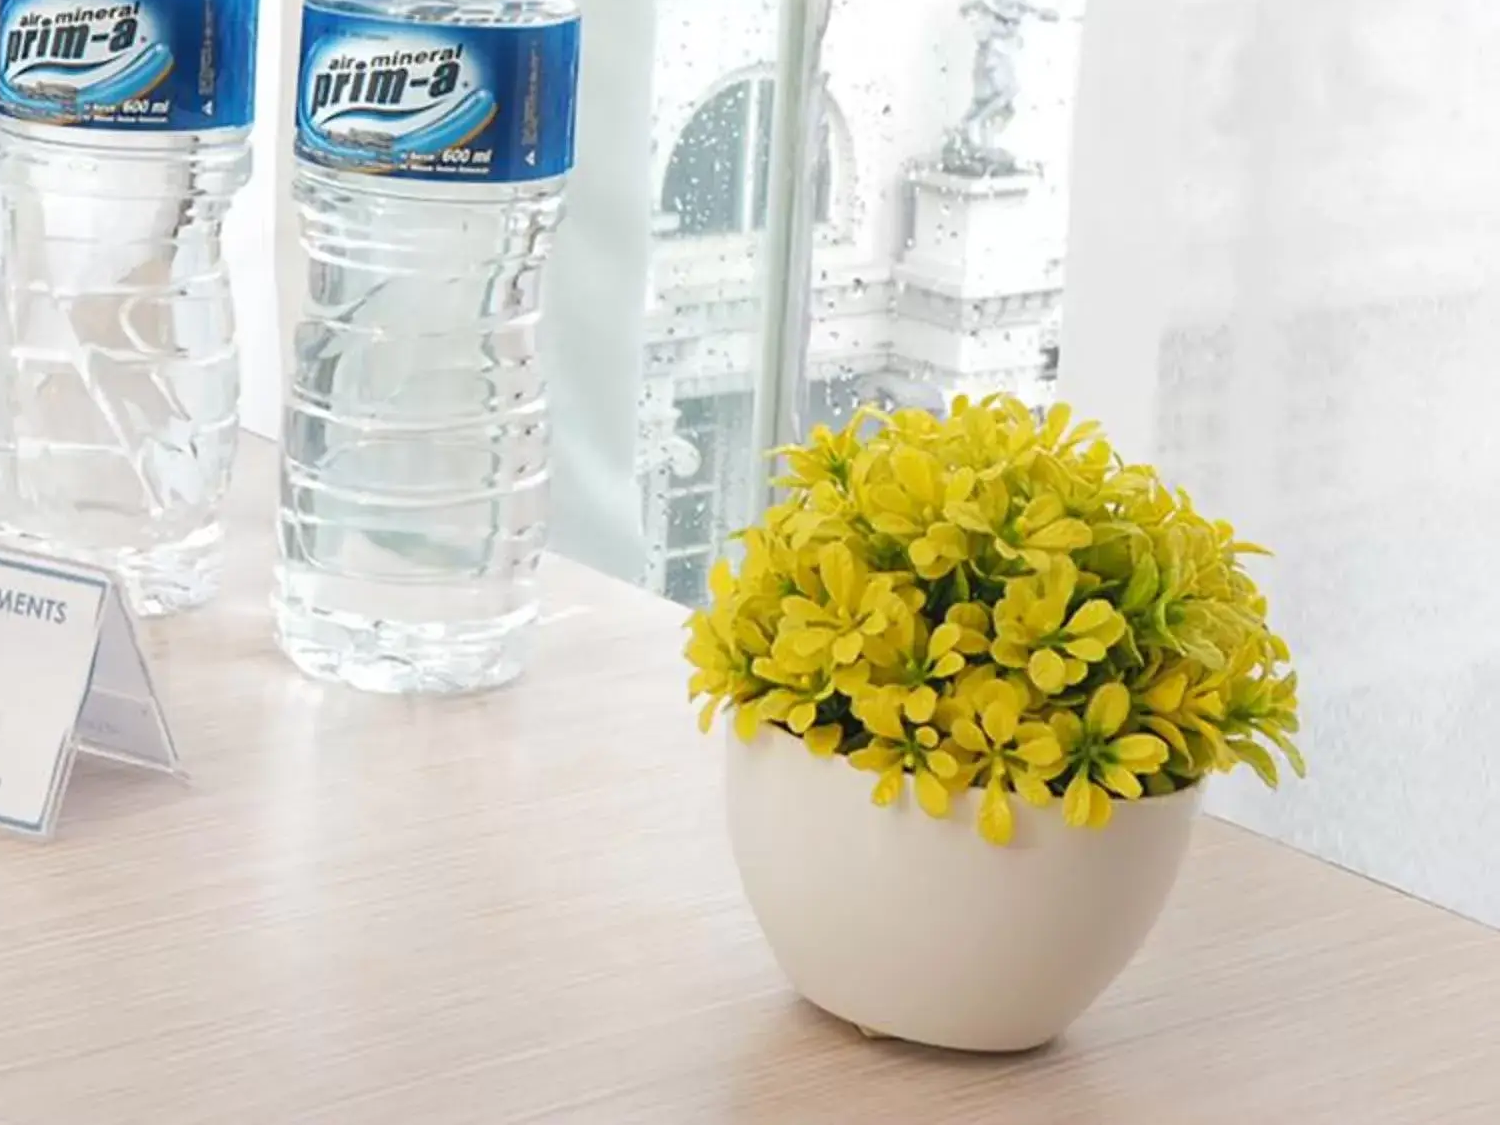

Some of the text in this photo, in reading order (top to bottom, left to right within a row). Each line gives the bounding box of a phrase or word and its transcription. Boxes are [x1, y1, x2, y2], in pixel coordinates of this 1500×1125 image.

[19, 0, 141, 27] air mineral
[5, 17, 139, 73] prim-a
[328, 42, 464, 70] air mineral
[310, 60, 461, 117] prim-a
[441, 148, 471, 164] 600
